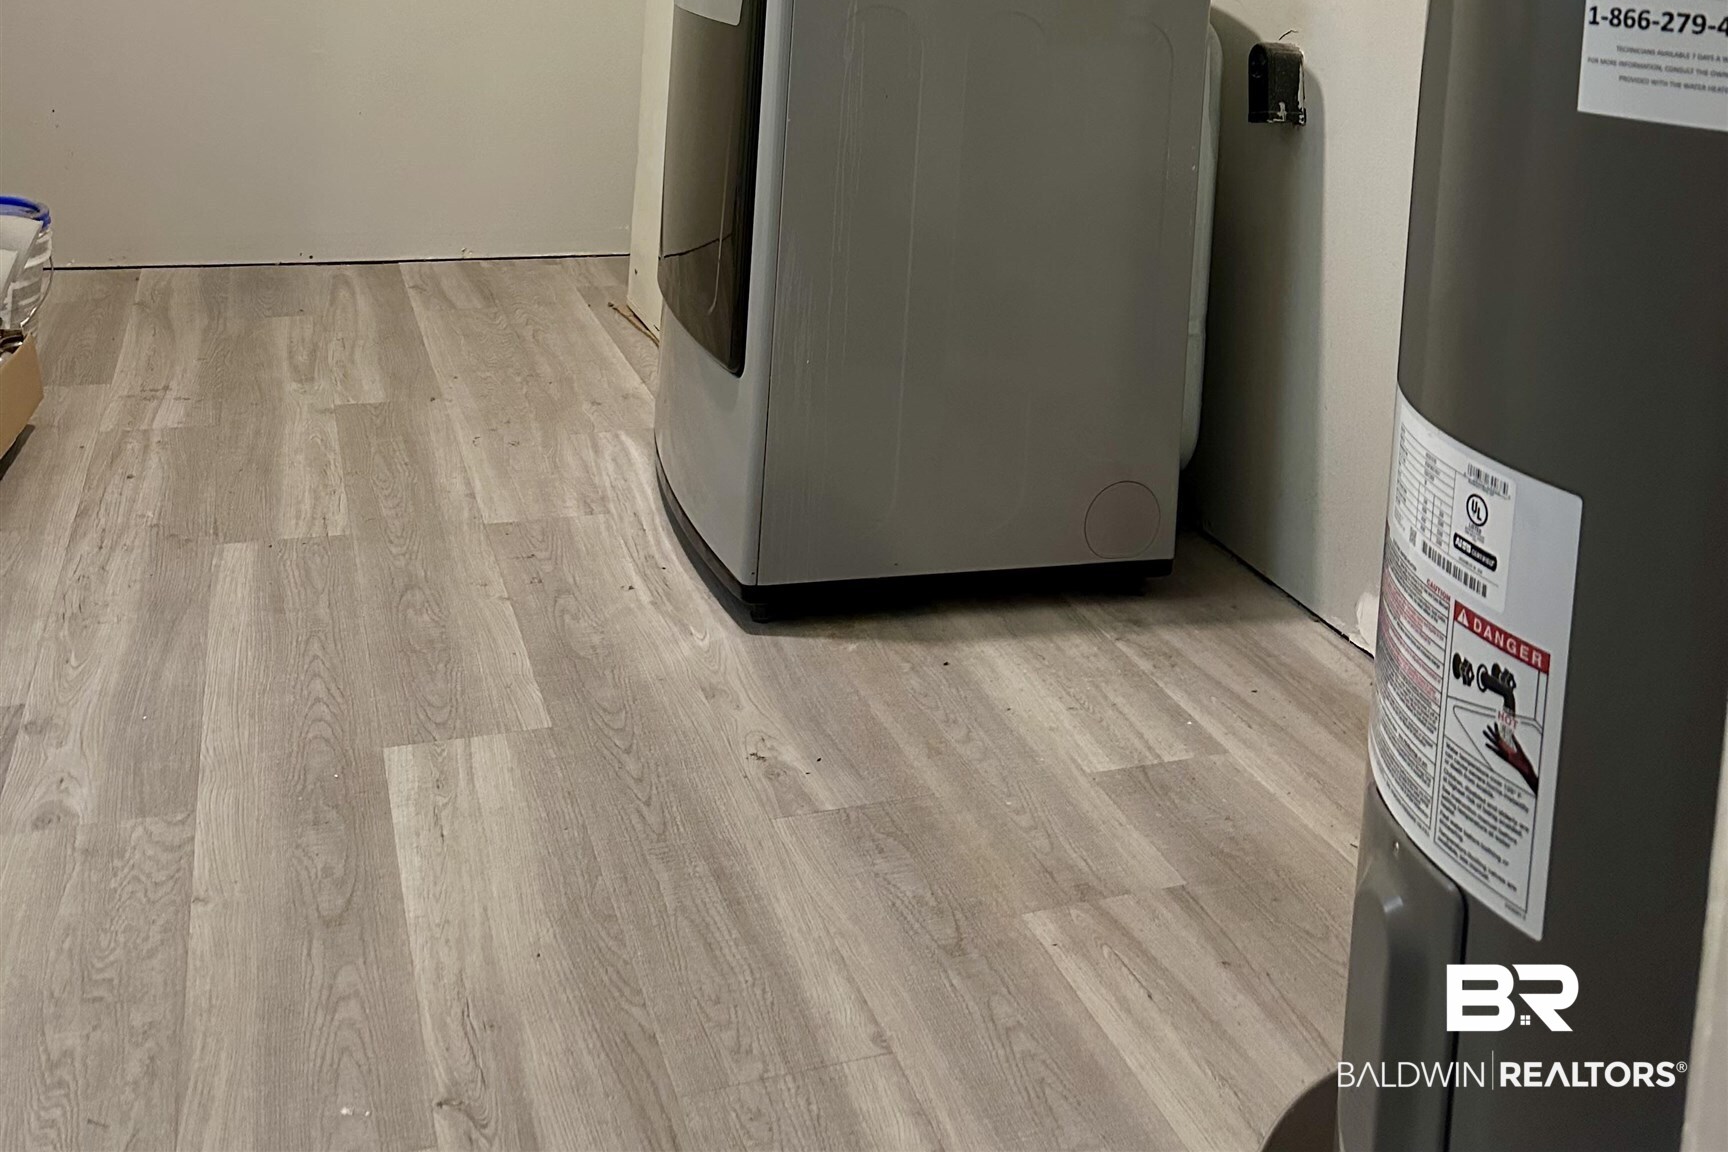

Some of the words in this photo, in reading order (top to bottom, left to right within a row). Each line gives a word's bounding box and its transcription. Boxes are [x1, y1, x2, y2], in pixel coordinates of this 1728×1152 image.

[1426, 578, 1451, 601] CAUTION
[1473, 618, 1542, 668] DANGER
[1497, 710, 1519, 729] HOT
